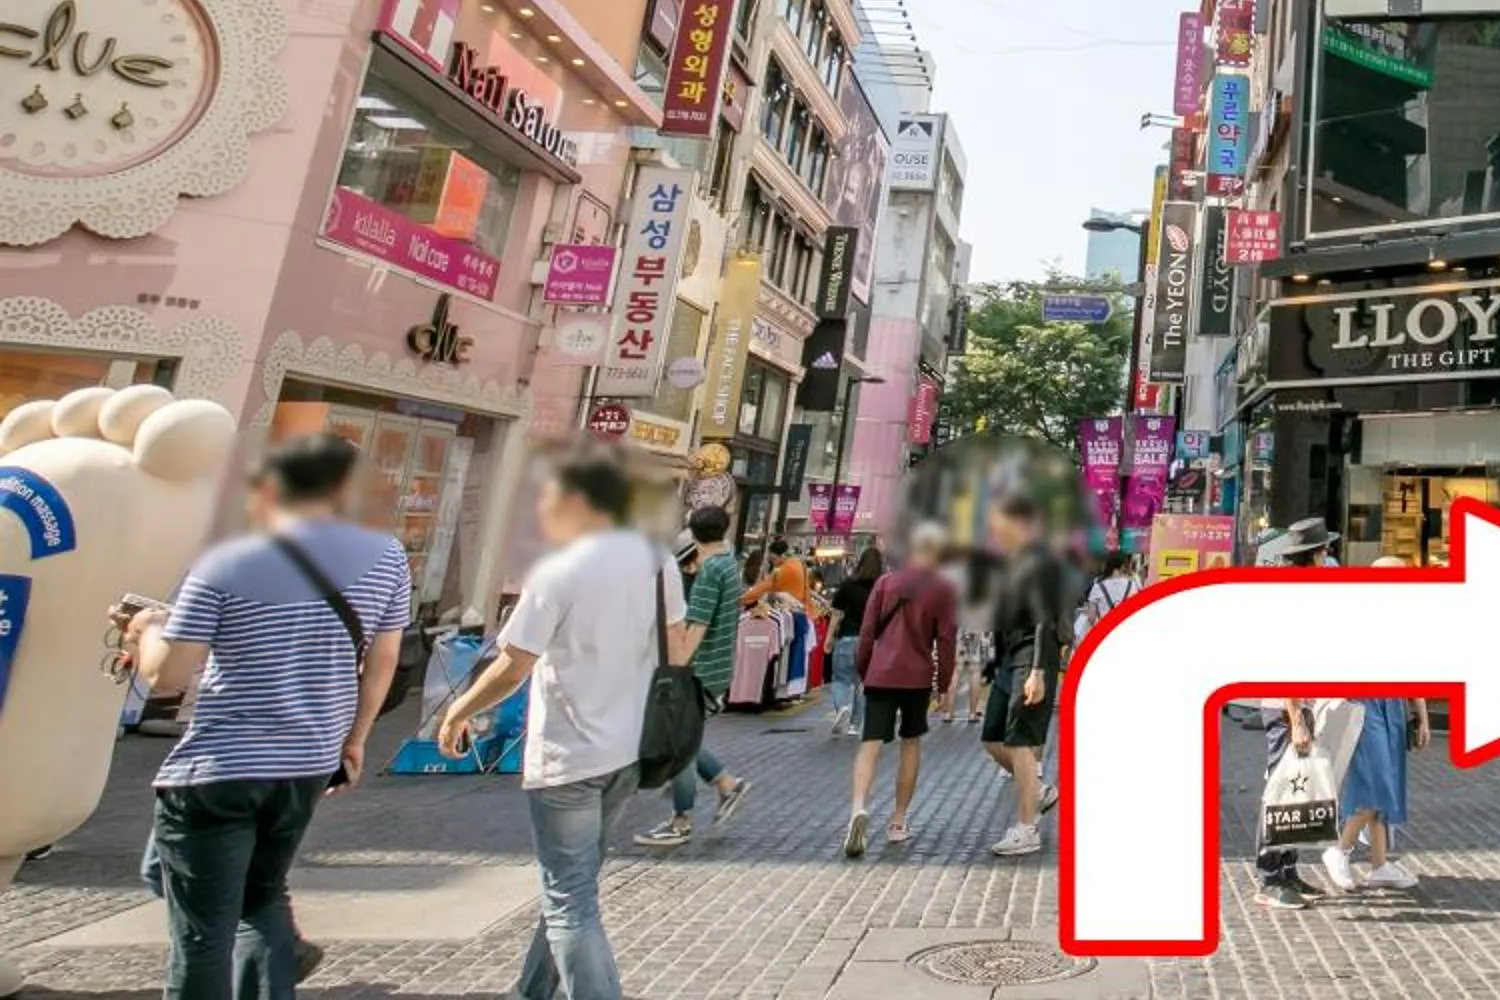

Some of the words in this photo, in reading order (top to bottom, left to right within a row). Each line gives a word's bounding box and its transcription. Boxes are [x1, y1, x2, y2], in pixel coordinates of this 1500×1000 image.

[677, 4, 719, 104] 성형외과
[453, 42, 506, 117] Nail
[509, 87, 569, 162] Salon
[1166, 250, 1187, 308] YEON
[1163, 312, 1184, 350] The
[1387, 351, 1433, 370] THE
[1438, 348, 1495, 367] GIFT
[30, 494, 62, 548] massage
[1265, 810, 1302, 826] STAR
[1309, 806, 1335, 822] 101
